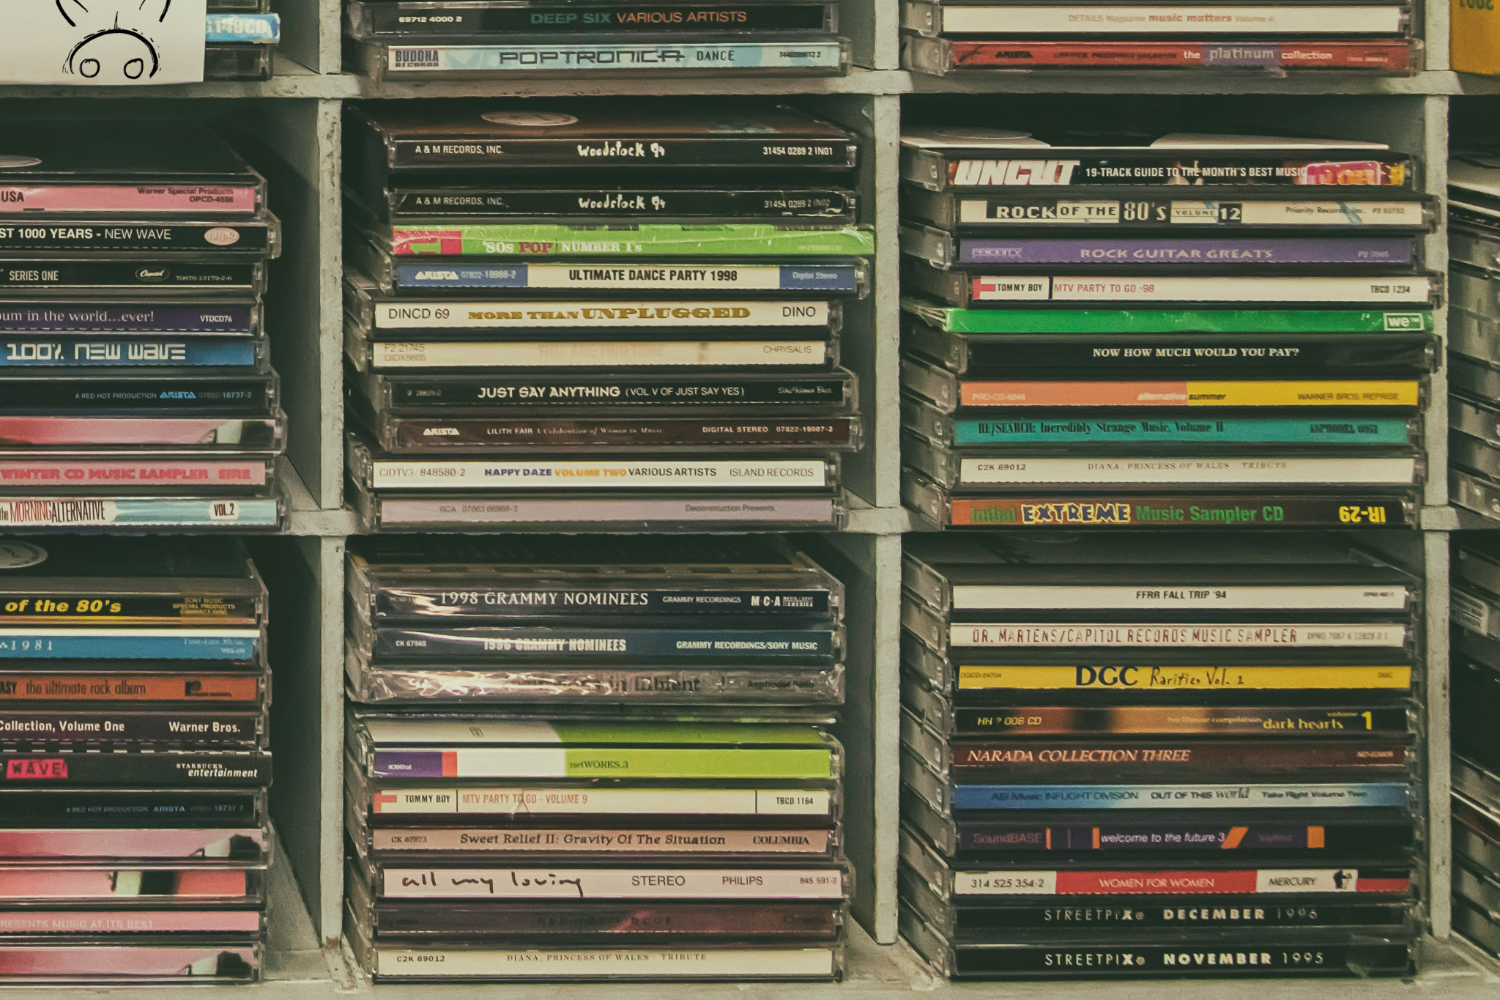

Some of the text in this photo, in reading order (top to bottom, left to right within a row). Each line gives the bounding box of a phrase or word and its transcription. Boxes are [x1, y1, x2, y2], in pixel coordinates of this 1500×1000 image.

[19, 229, 46, 238] 1000
[50, 229, 93, 238] YEARS
[105, 229, 132, 239] NEW
[136, 229, 171, 239] WAVE
[1081, 250, 1272, 258] ROCK GUITAR GREATS
[570, 270, 737, 281] ULTIMATE DANCE PARTY 1998
[1022, 502, 1283, 524] EXTREME Music Sampler CD
[6, 600, 29, 611] of
[35, 600, 68, 612] the
[76, 600, 121, 612] 80's
[1076, 666, 1138, 687] DGC
[1150, 669, 1200, 686] Rarities
[1205, 667, 1230, 685] Vol.
[59, 721, 99, 731] Volume
[104, 721, 124, 732] One
[169, 722, 208, 732] Warner
[213, 722, 240, 732] Bros.
[402, 872, 763, 897] all my loving STEREO PHILIPS
[1099, 877, 1316, 887] WOMEN FOR WOMEN MERCURY
